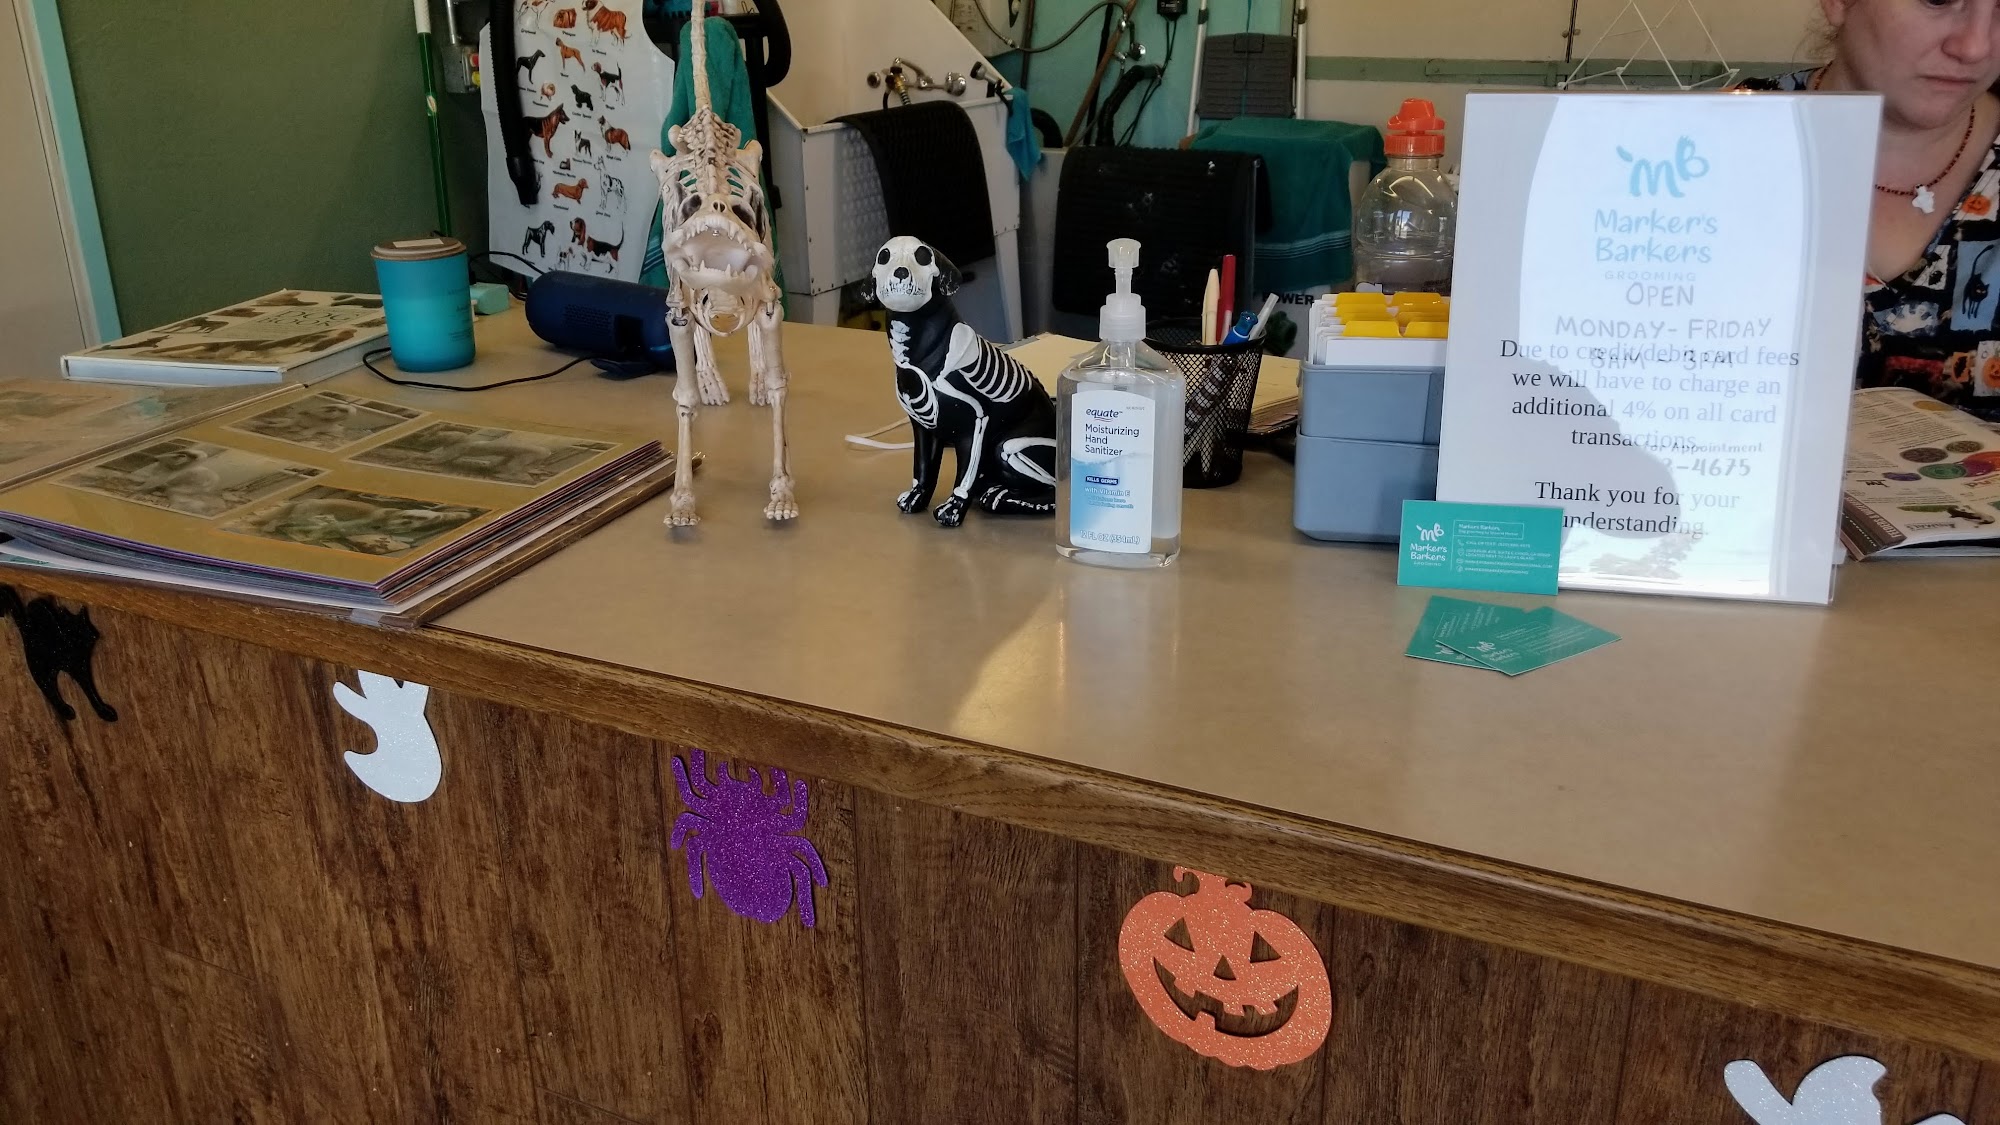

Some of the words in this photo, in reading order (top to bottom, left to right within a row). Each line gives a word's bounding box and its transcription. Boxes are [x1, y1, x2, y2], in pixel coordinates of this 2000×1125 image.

[1594, 208, 1718, 234] Marker's
[1595, 237, 1712, 264] Barkers
[1604, 271, 1697, 282] GROOMING
[1262, 292, 1314, 305] PWER
[1626, 282, 1695, 307] OPEN
[1688, 318, 1772, 339] FRIDAY
[1500, 339, 1542, 358] Due
[1550, 344, 1569, 359] to
[1577, 341, 1692, 362] credit/debit
[1703, 346, 1748, 364] card
[1757, 346, 1799, 366] fees
[1512, 372, 1542, 386] we
[1548, 369, 1587, 388] will
[1596, 370, 1645, 389] have
[1653, 375, 1672, 390] to
[1679, 373, 1750, 398] charge
[1756, 380, 1781, 394] an
[1512, 396, 1614, 418] additional
[1622, 399, 1657, 419] 4%
[1664, 406, 1689, 420] on
[1697, 402, 1723, 422] all
[1731, 405, 1776, 423] card
[1085, 423, 1140, 438] Moisturizing
[1085, 433, 1108, 445] Hand
[1085, 444, 1123, 456] Sanitizer
[1535, 481, 1601, 502] Thank
[1606, 489, 1646, 507] you
[1654, 486, 1685, 506] for
[1692, 493, 1740, 511] your
[1410, 543, 1448, 553] Marker's
[1411, 552, 1446, 561] Barkers
